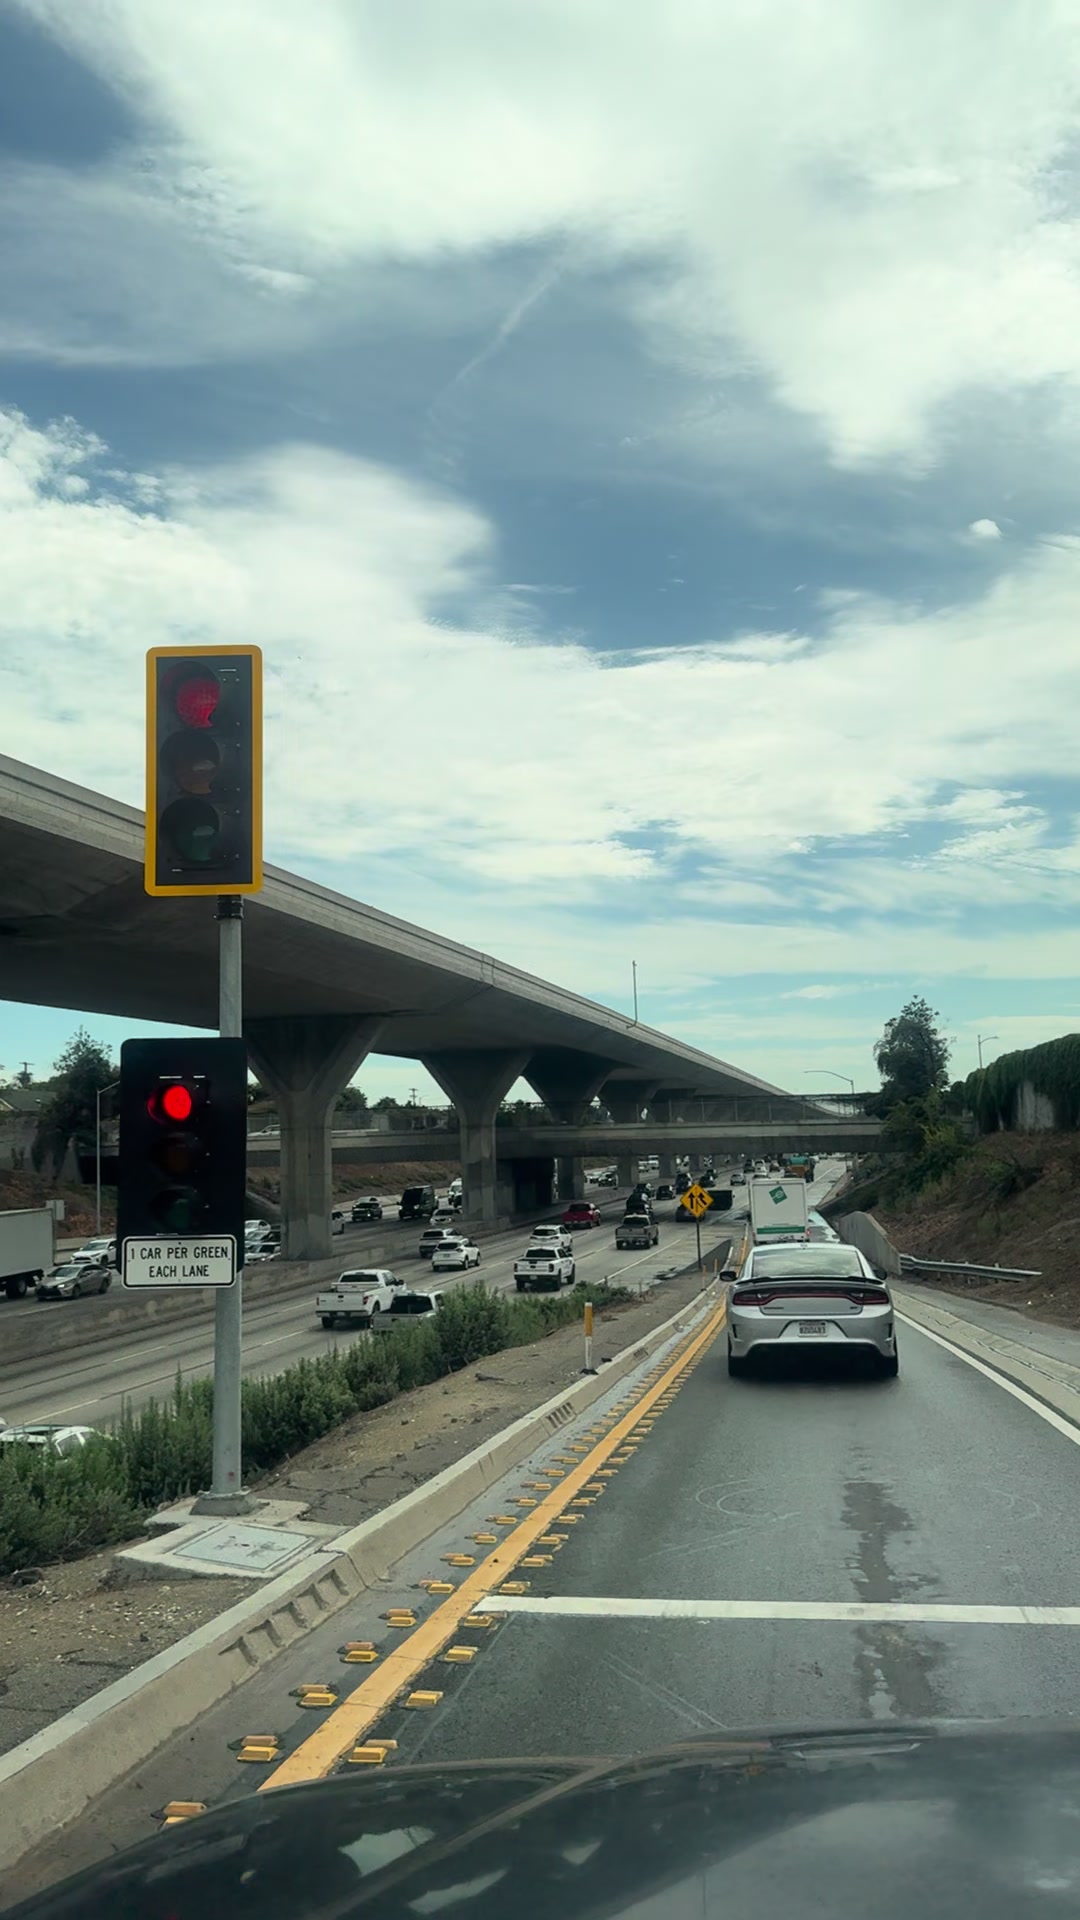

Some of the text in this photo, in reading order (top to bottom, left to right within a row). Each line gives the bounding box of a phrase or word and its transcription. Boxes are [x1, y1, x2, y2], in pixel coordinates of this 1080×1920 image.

[131, 1246, 228, 1260] 1 CAR PER GREEN
[149, 1265, 209, 1278] EACH LANE
